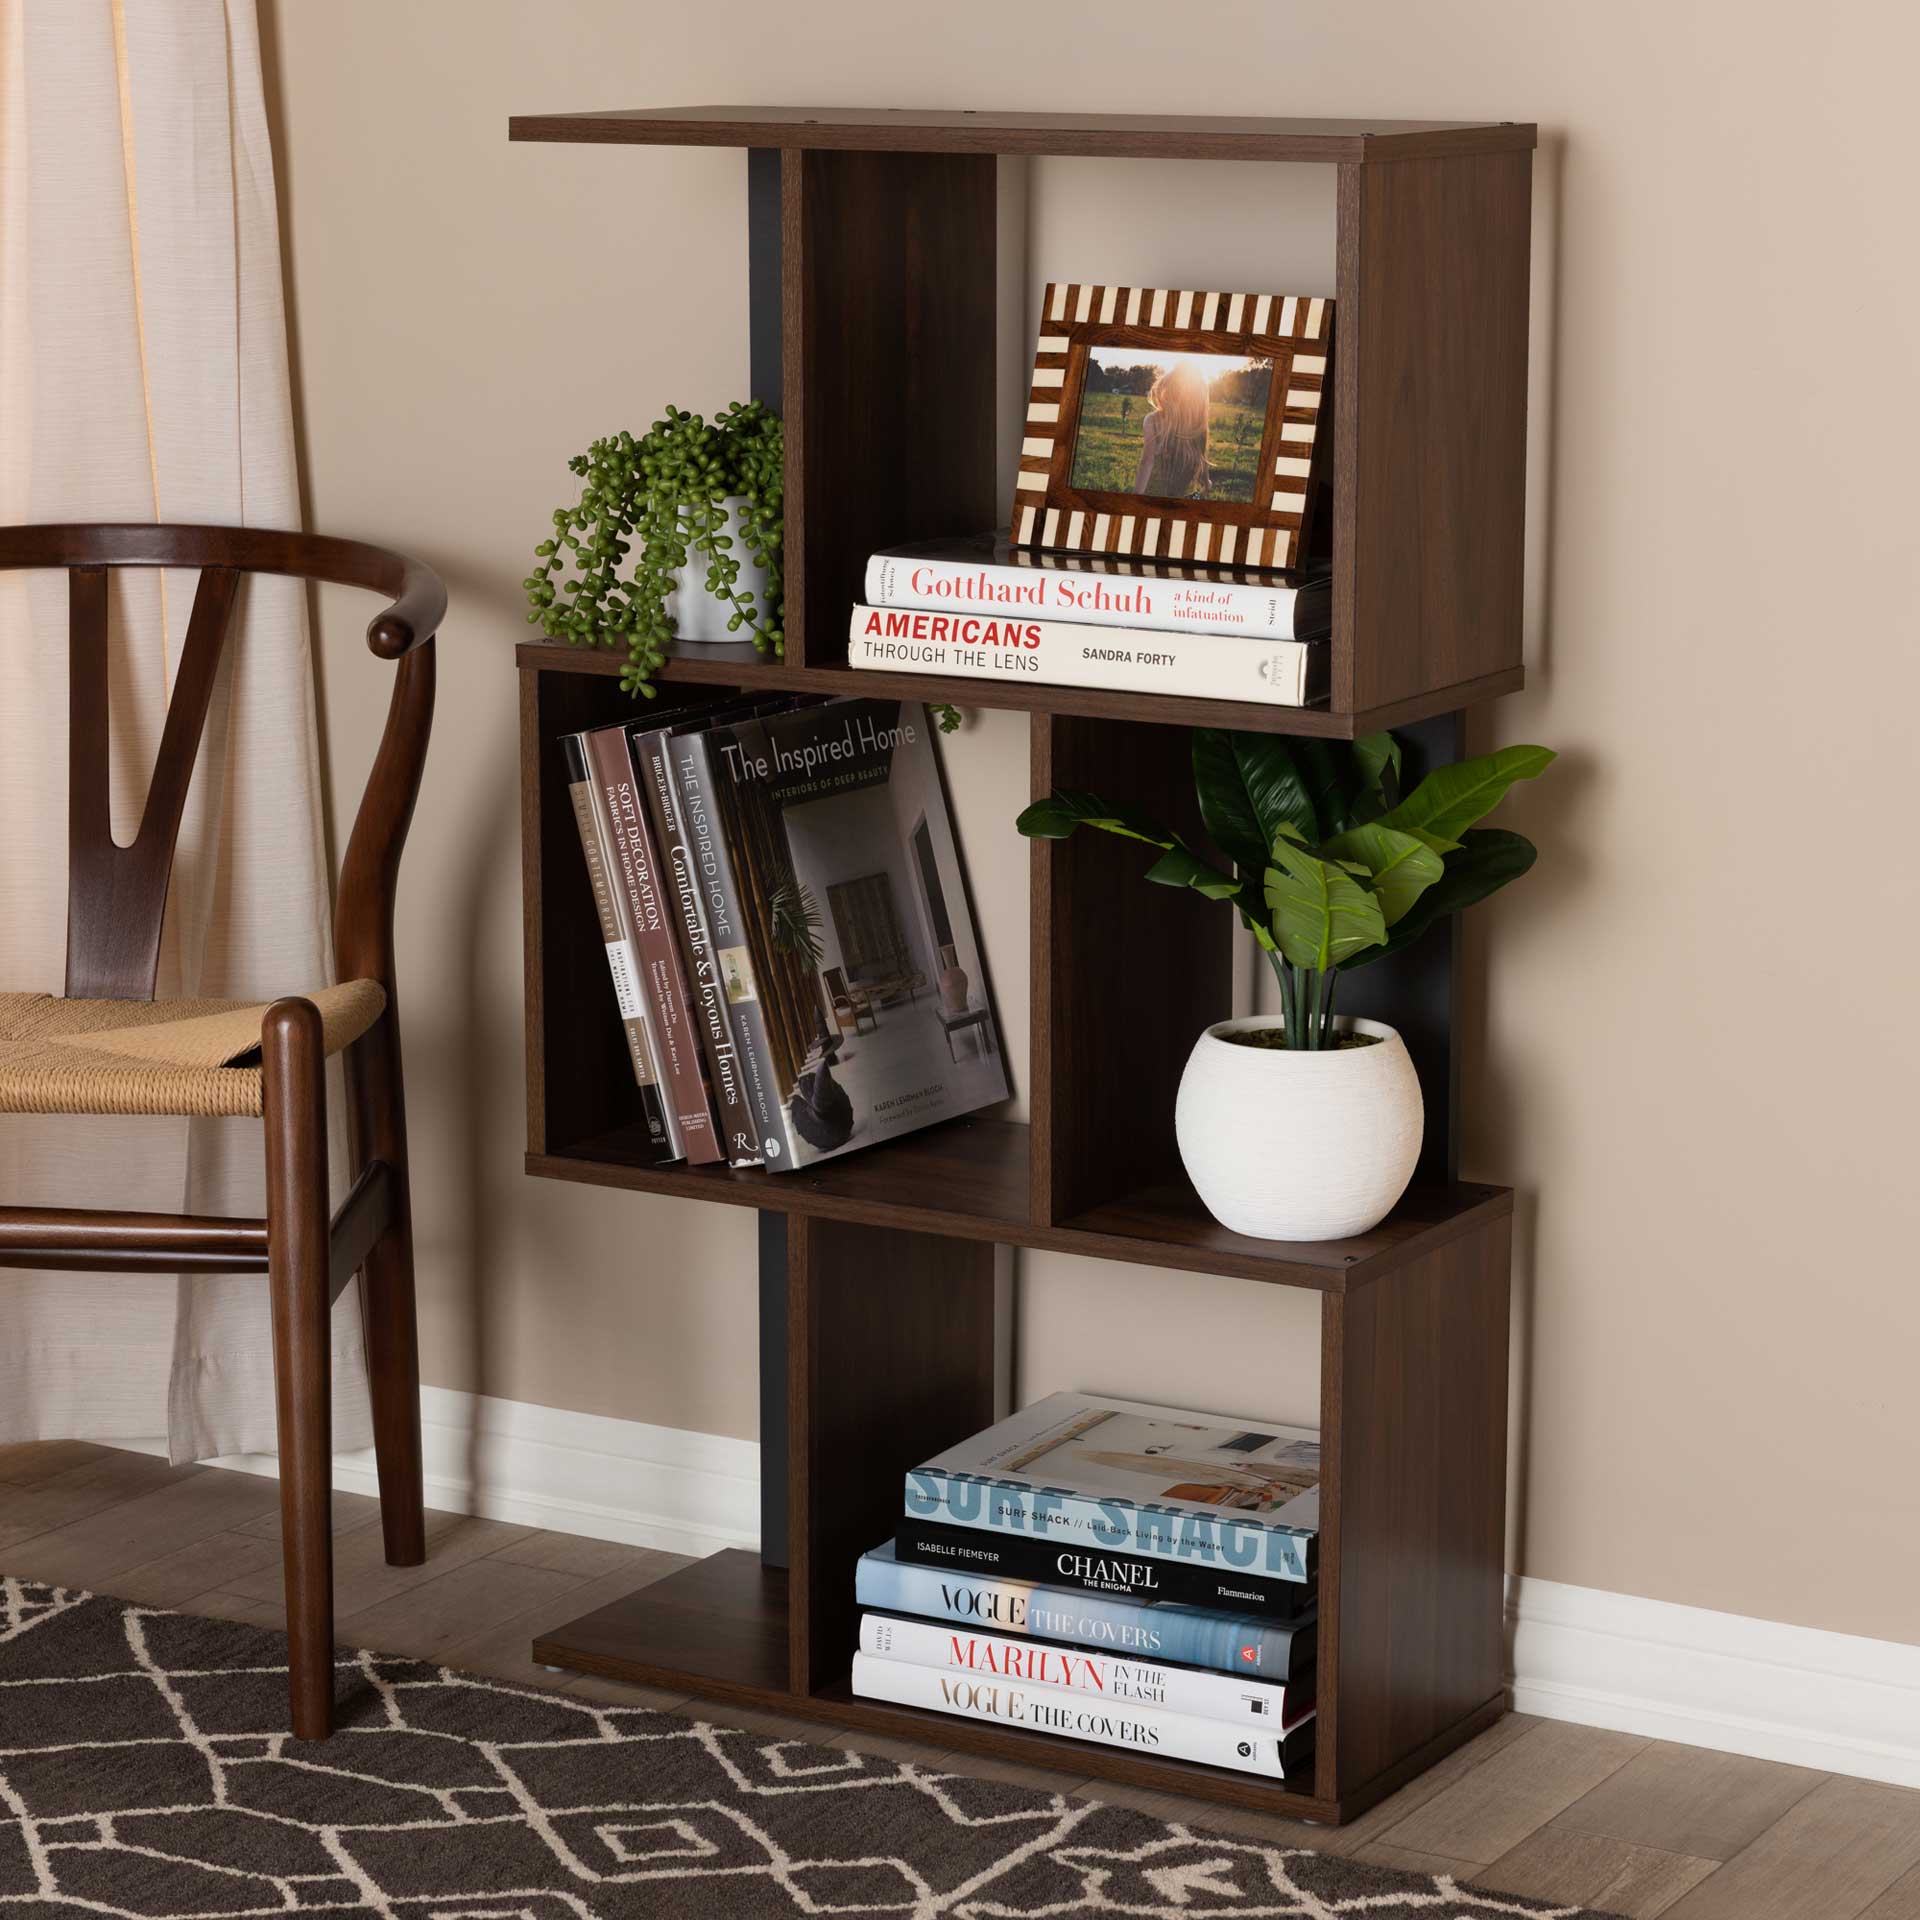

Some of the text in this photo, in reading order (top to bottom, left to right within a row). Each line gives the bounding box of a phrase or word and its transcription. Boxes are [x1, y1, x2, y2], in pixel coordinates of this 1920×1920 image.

[911, 567, 1152, 615] Gotthard Schuh
[1173, 605, 1245, 623] infatuation
[1174, 589, 1233, 605] a kind of
[864, 611, 1042, 649] AMERICANS
[864, 641, 1039, 672] THROUGH THE LENS
[1082, 647, 1176, 666] SANDRA FORTY
[720, 716, 917, 783] The Inspired Home
[771, 766, 889, 800] INTERIORS OF DEEP BEAUTY
[606, 786, 646, 932] FABRICS IN HOME DESIGN
[617, 782, 662, 931] SOFT DECORATION
[680, 754, 732, 937] THE INSPIRED HOME
[585, 840, 616, 937] CONTEMPORARY
[670, 845, 738, 1106] Comfortable & Joyous Homes
[739, 1014, 769, 1123] KAREN LEHRMAN BLOCH
[905, 1467, 1316, 1577] SURF SHACK
[997, 1505, 1027, 1519] SURF
[1031, 1511, 1071, 1526] SHACK
[1087, 1520, 1132, 1537] Laid-Back
[1135, 1529, 1164, 1544] Living
[1167, 1535, 1178, 1545] by
[1181, 1537, 1196, 1547] the
[1199, 1540, 1225, 1552] Water
[917, 1541, 1000, 1562] ISABELLE FIEMEYER
[1056, 1553, 1159, 1589] CHANEL
[1083, 1578, 1132, 1593] THE ENIGMA
[1217, 1586, 1265, 1602] Flammarion
[941, 1584, 1161, 1650] VOGUE THE COVERS
[949, 1635, 1108, 1691] MARILYN
[1114, 1665, 1167, 1687] IN THE
[940, 1678, 1160, 1746] VOGUE THE COVERS
[1114, 1681, 1165, 1703] FLASH
